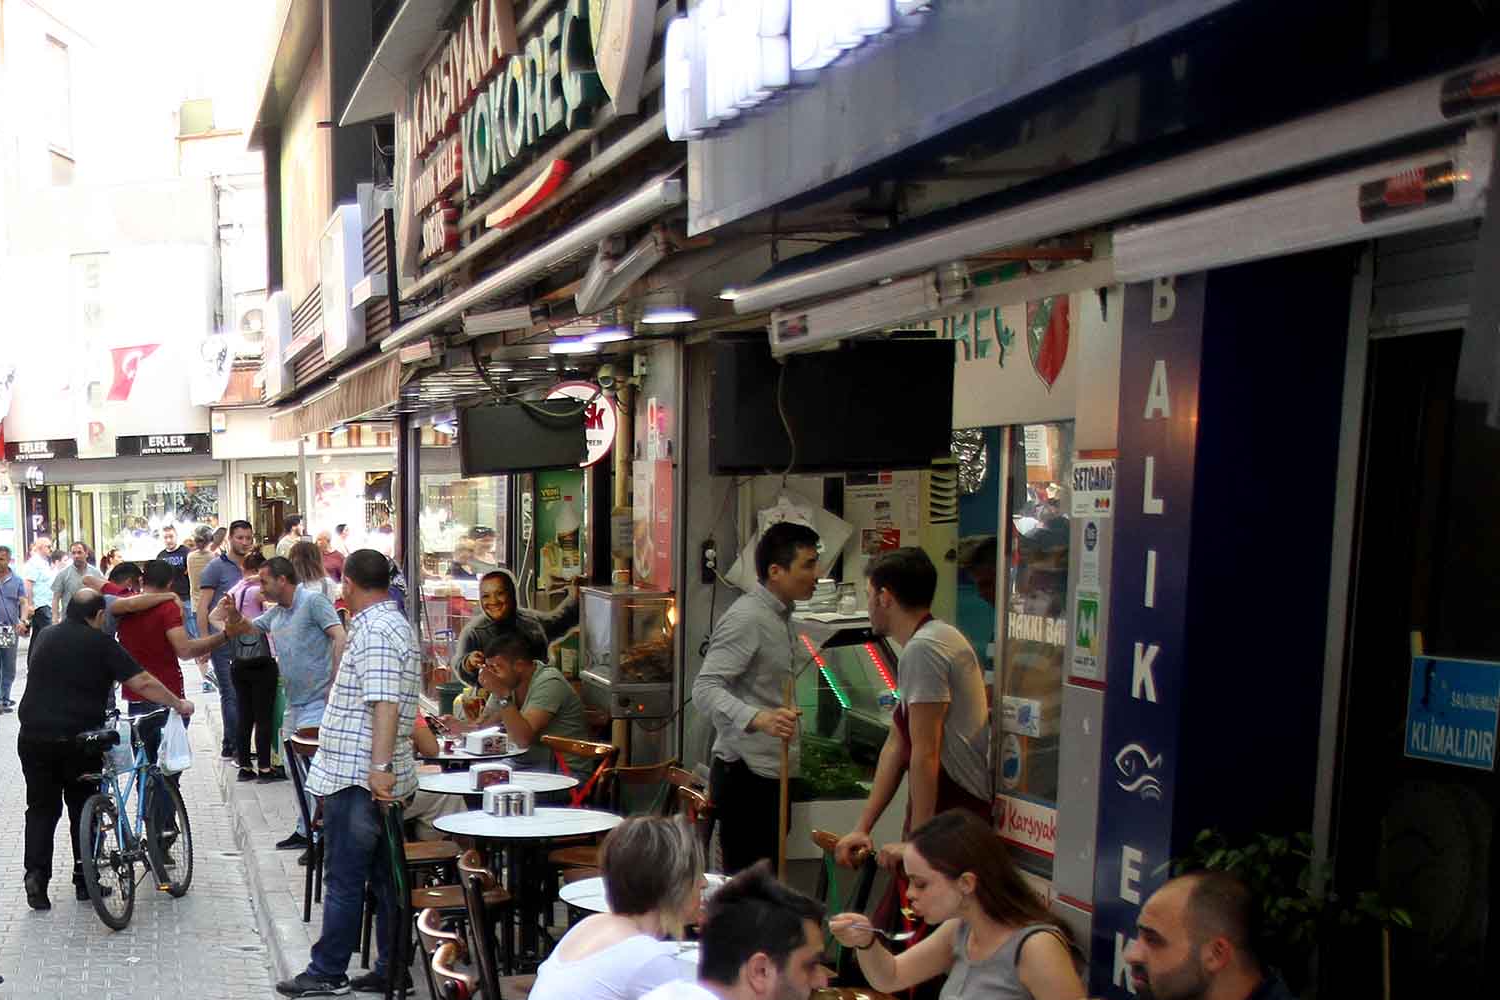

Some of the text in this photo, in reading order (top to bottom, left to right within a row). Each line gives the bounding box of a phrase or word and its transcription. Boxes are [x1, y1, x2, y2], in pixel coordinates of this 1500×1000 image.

[148, 435, 187, 448] ERLER
[1131, 274, 1176, 704] BALIK
[1411, 713, 1494, 762] KLİMALIDIR
